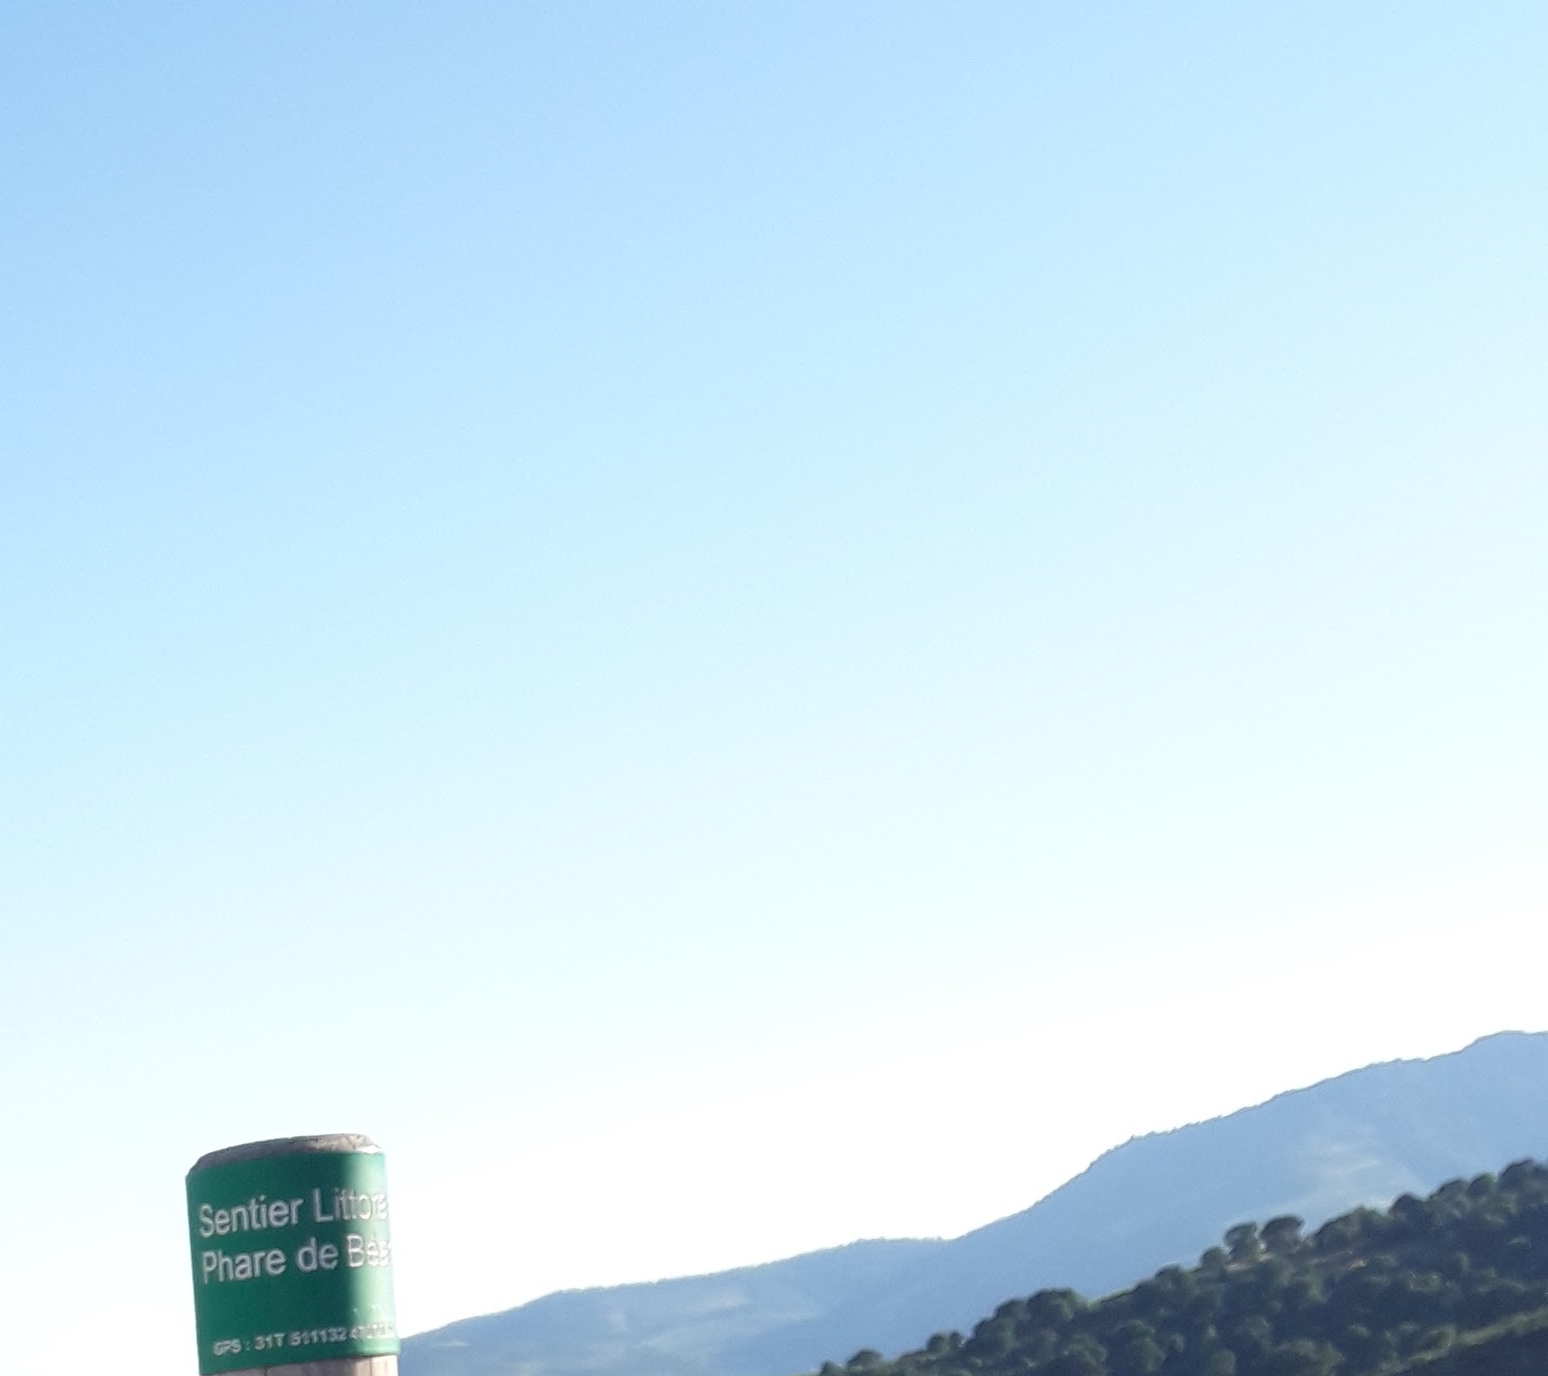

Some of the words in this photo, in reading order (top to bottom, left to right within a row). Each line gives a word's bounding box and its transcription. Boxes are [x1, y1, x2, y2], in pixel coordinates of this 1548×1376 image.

[199, 1194, 303, 1238] Sentier
[202, 1247, 287, 1285] Phare
[296, 1235, 340, 1273] de
[346, 1231, 391, 1268] Béa
